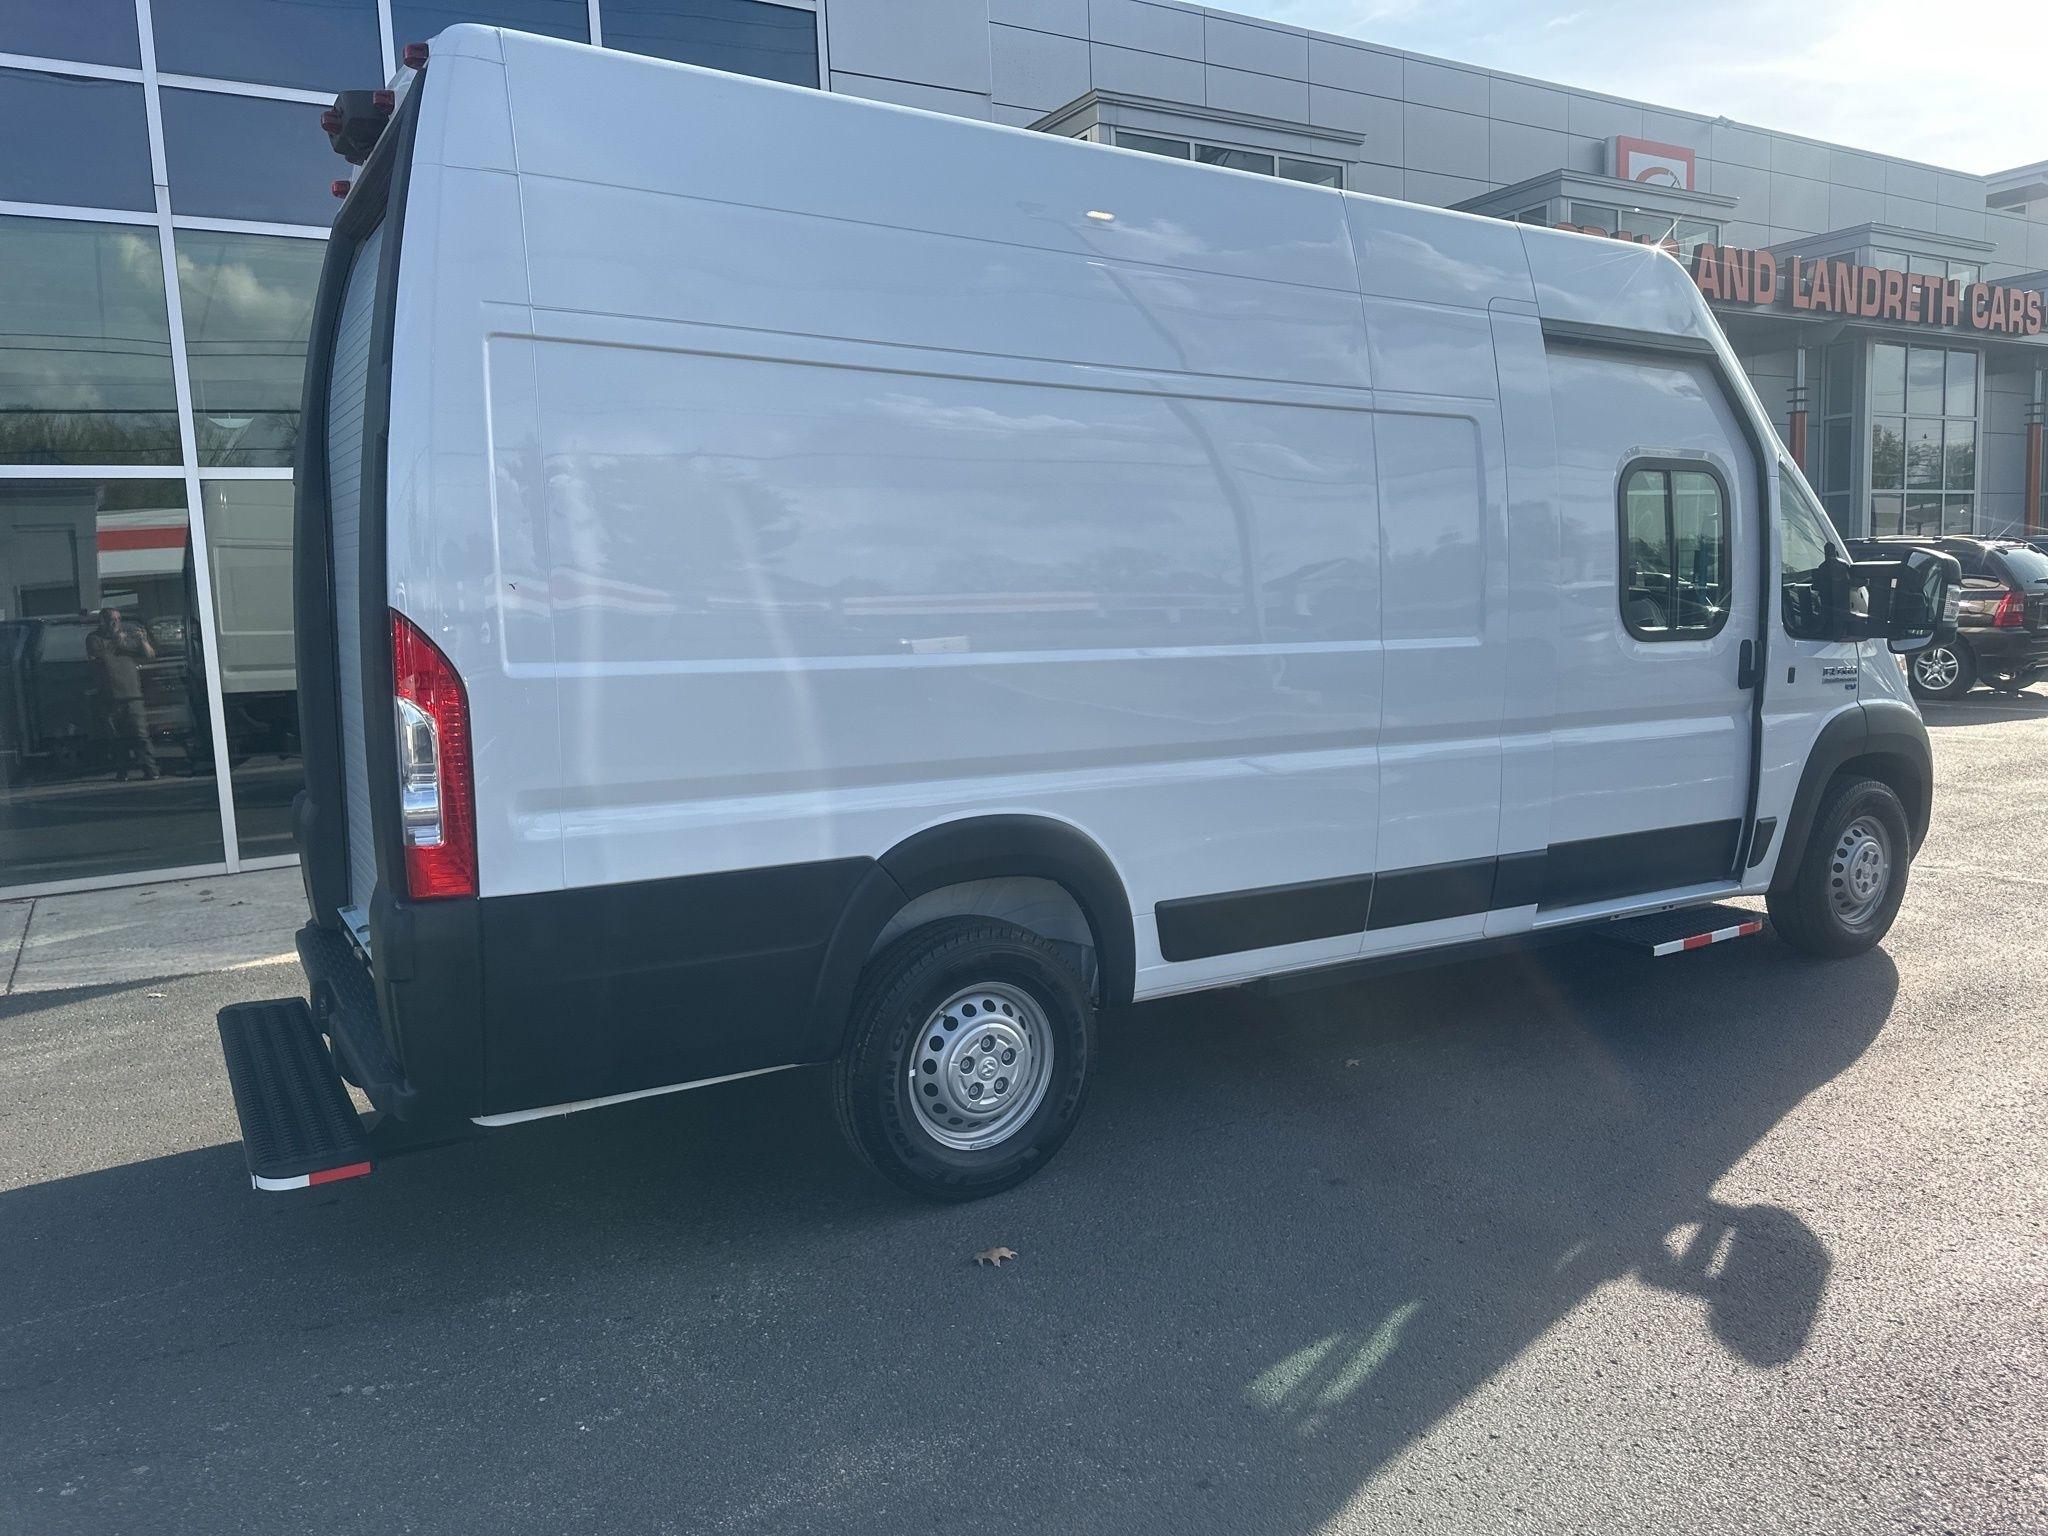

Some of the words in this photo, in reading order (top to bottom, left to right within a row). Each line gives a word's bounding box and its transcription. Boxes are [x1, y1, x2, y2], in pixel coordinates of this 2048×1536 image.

[1693, 243, 1777, 305] AND
[1788, 255, 1961, 326] LANDRETH
[1967, 281, 2042, 335] CARS
